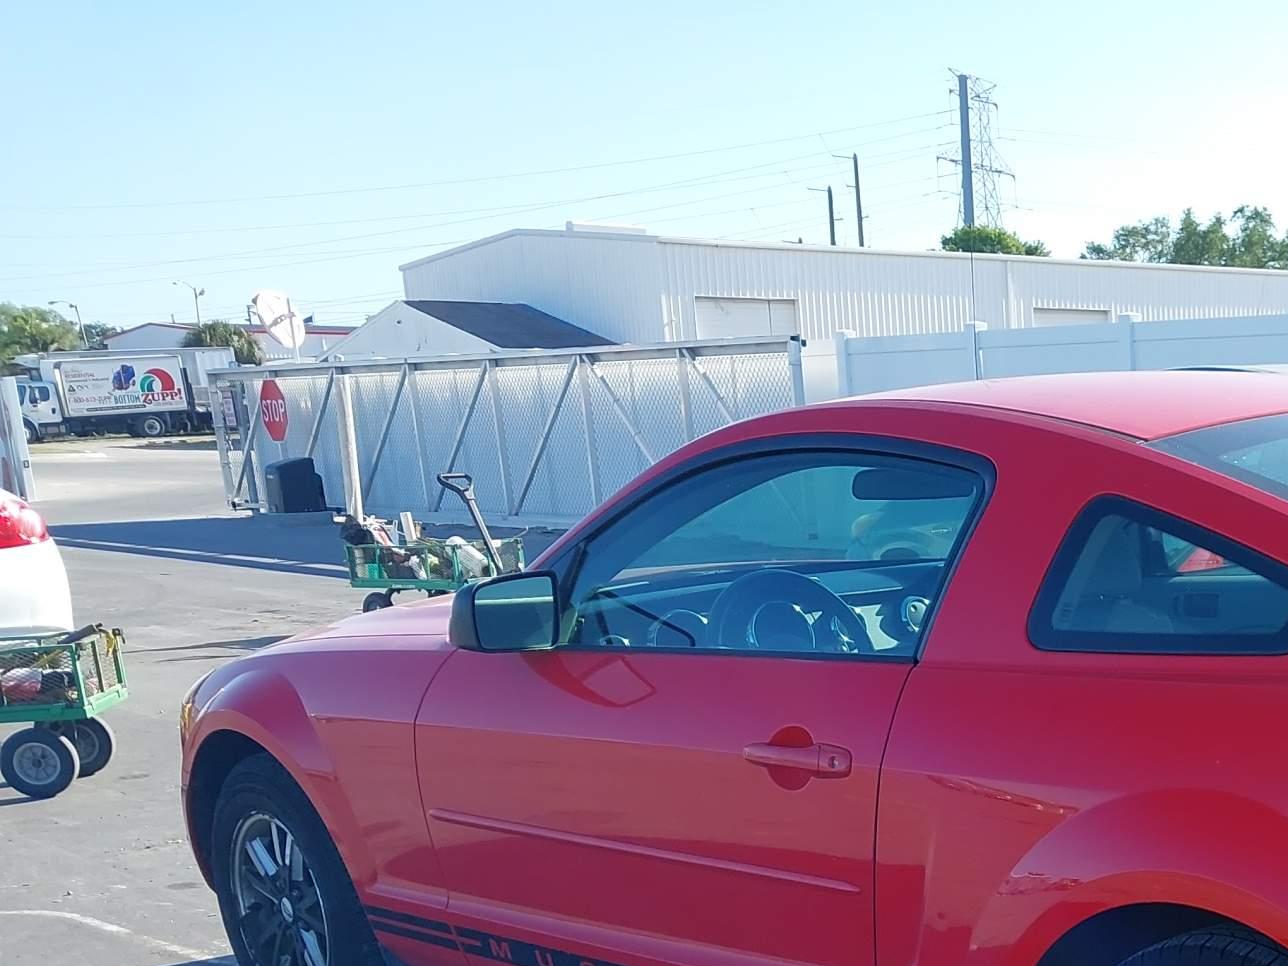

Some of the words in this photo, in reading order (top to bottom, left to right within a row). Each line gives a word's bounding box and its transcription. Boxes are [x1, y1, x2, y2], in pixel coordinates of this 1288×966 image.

[113, 394, 141, 405] BOTTOM
[142, 388, 183, 405] ZUPP!
[262, 400, 285, 422] STOP
